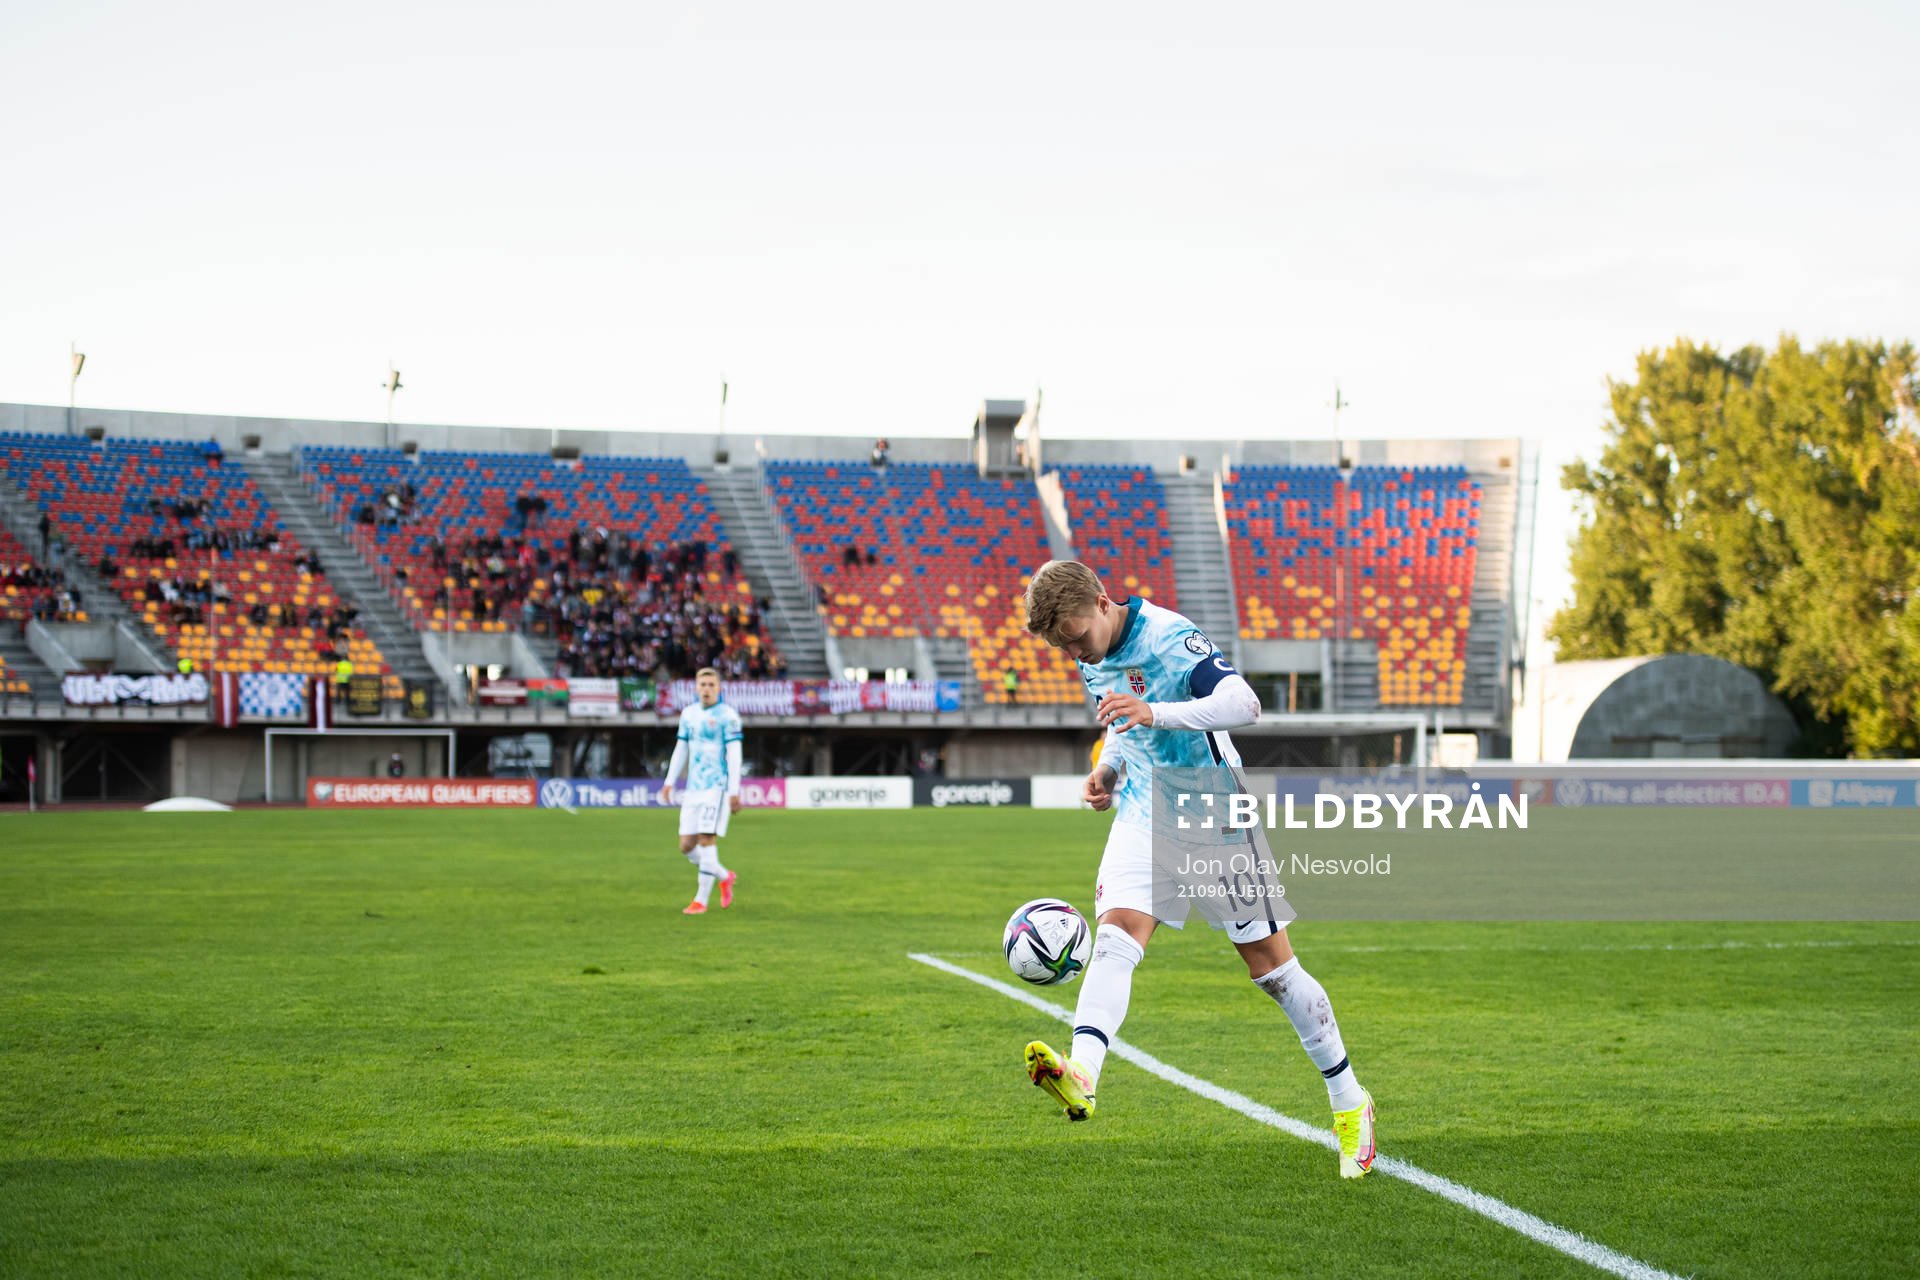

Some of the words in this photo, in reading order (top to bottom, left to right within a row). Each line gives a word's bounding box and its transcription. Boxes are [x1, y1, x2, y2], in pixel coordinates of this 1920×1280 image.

[334, 783, 430, 803] EUROPEAN
[432, 784, 532, 804] QUALIFIERS
[576, 785, 617, 806] The
[809, 783, 887, 807] gorenje
[931, 781, 1013, 807] gorenje
[1590, 781, 1628, 803] The
[1631, 780, 1740, 803] all-electric
[1218, 869, 1258, 912] 10
